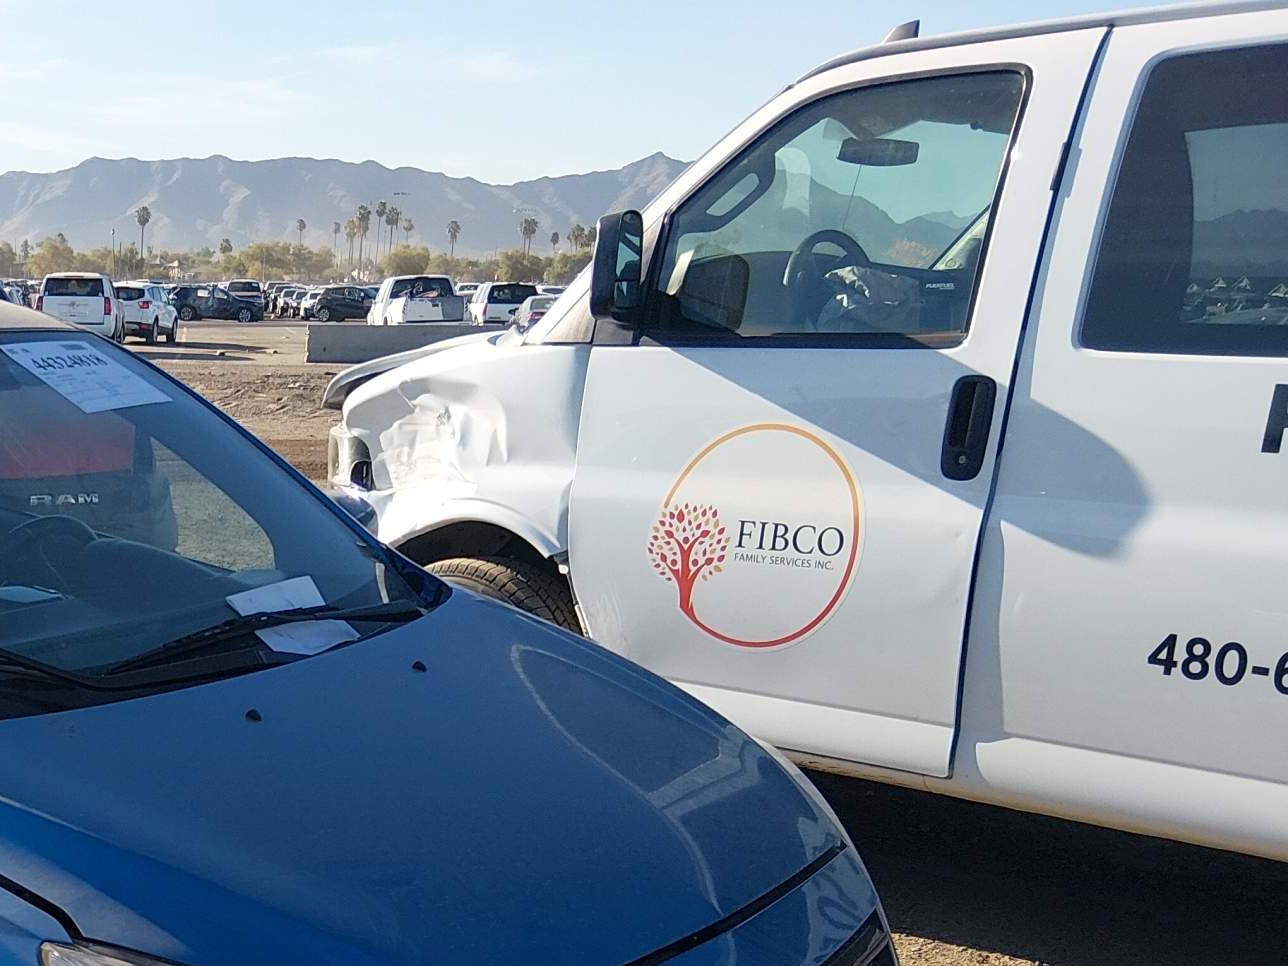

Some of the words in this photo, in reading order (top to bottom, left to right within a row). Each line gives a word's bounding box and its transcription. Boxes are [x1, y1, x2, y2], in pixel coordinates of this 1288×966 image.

[31, 354, 108, 371] 44324818
[30, 494, 99, 506] RAM
[735, 519, 844, 557] FIBCO
[734, 552, 768, 564] FAMILY
[768, 555, 812, 569] SERVICES
[814, 561, 834, 570] INC.
